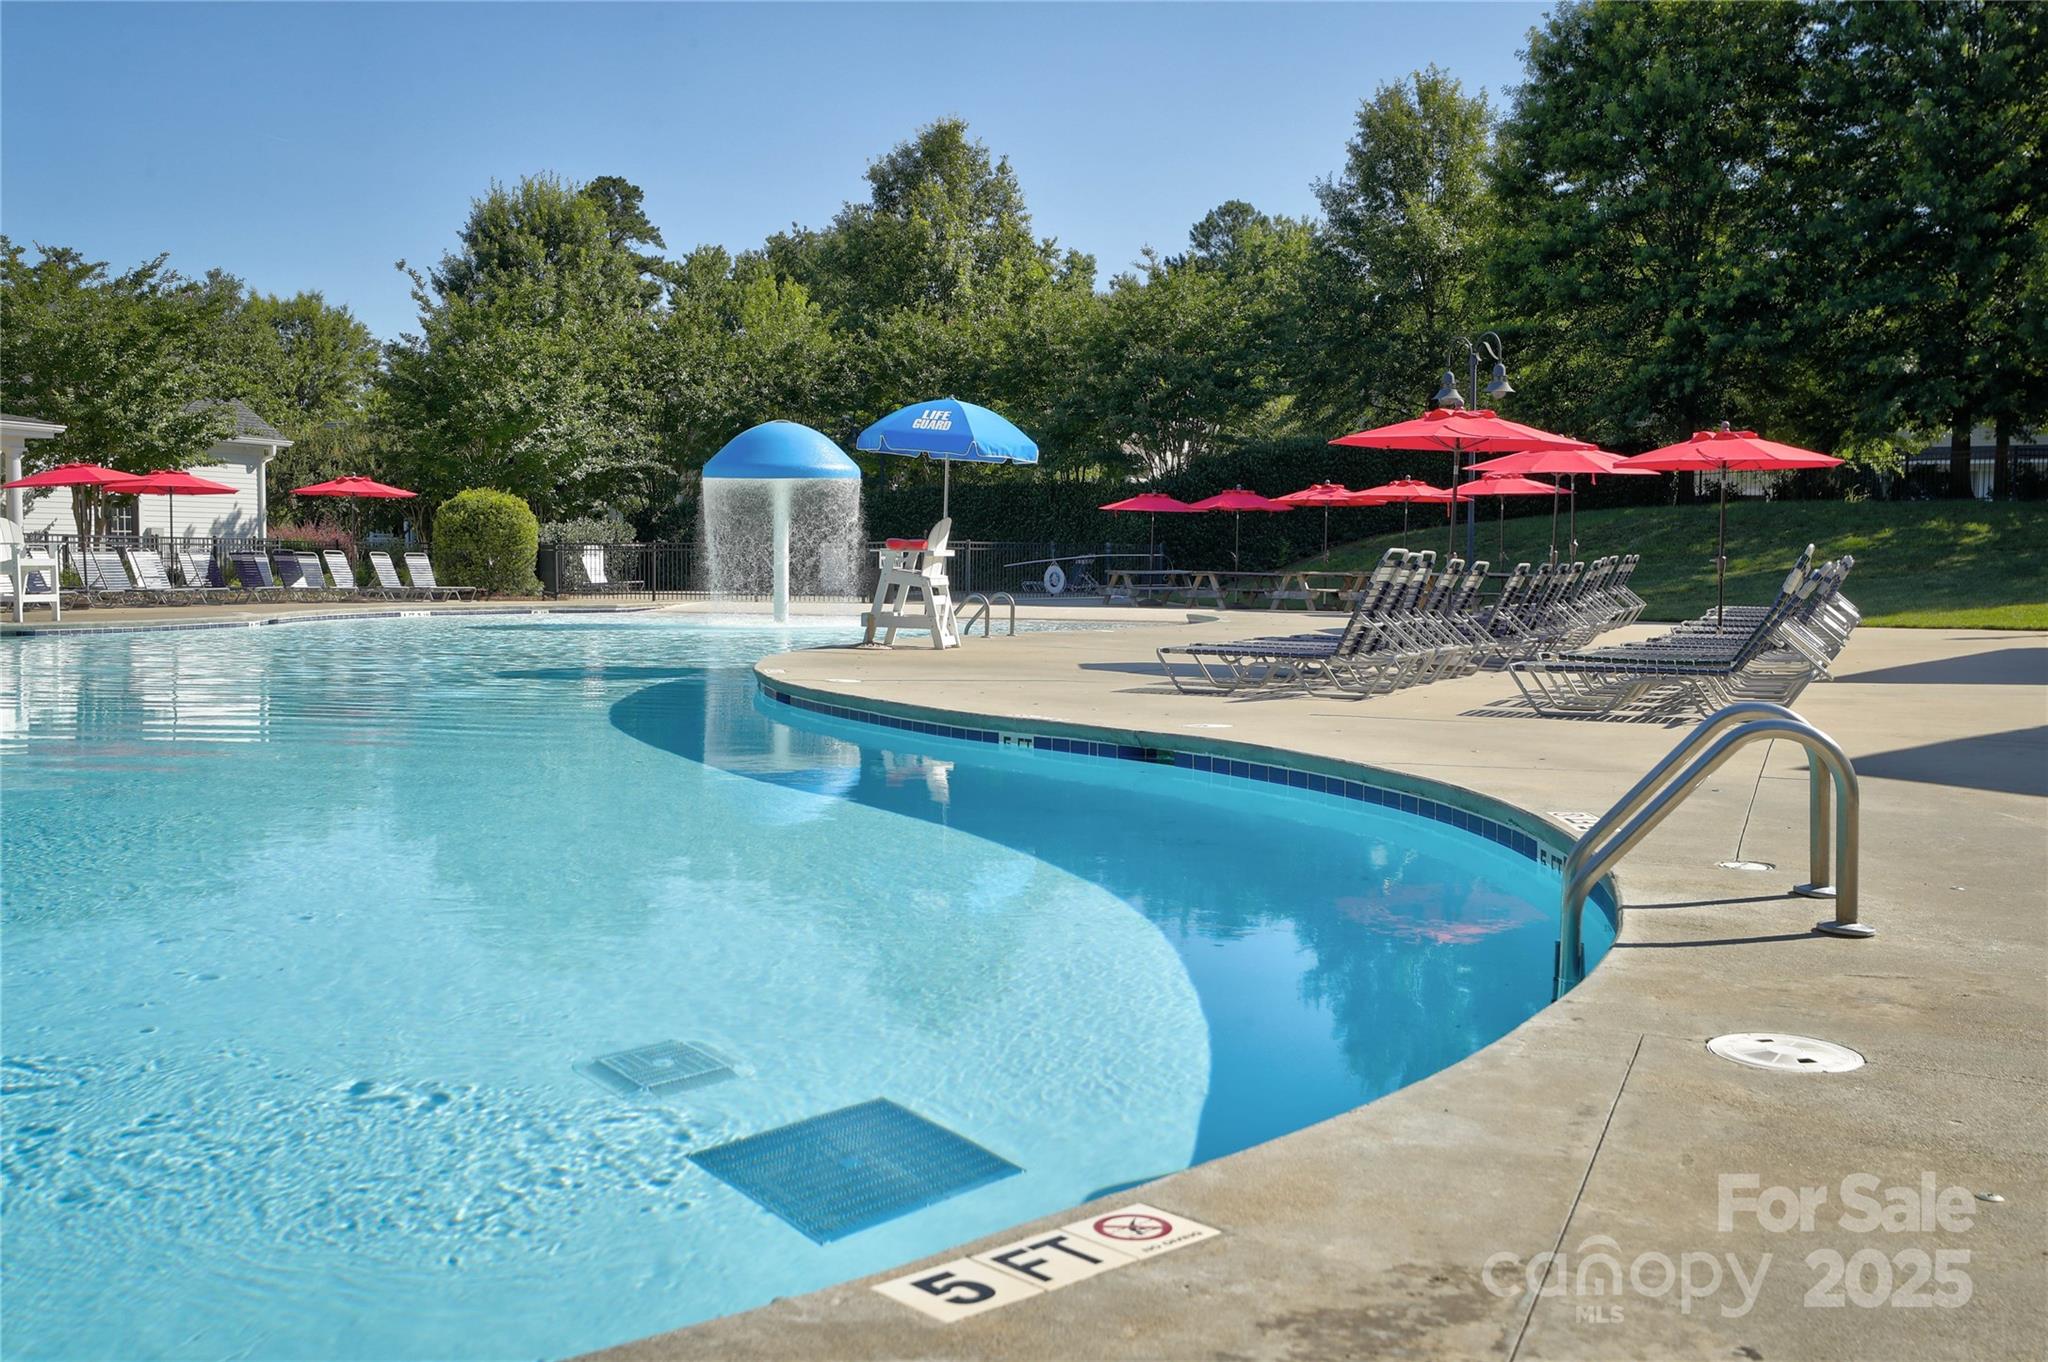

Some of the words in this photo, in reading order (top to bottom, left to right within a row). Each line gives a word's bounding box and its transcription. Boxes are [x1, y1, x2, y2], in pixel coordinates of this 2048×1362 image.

[922, 409, 952, 420] LIFE
[912, 419, 952, 431] GUARD
[909, 1271, 997, 1305] 5
[991, 1235, 1104, 1283] FT
